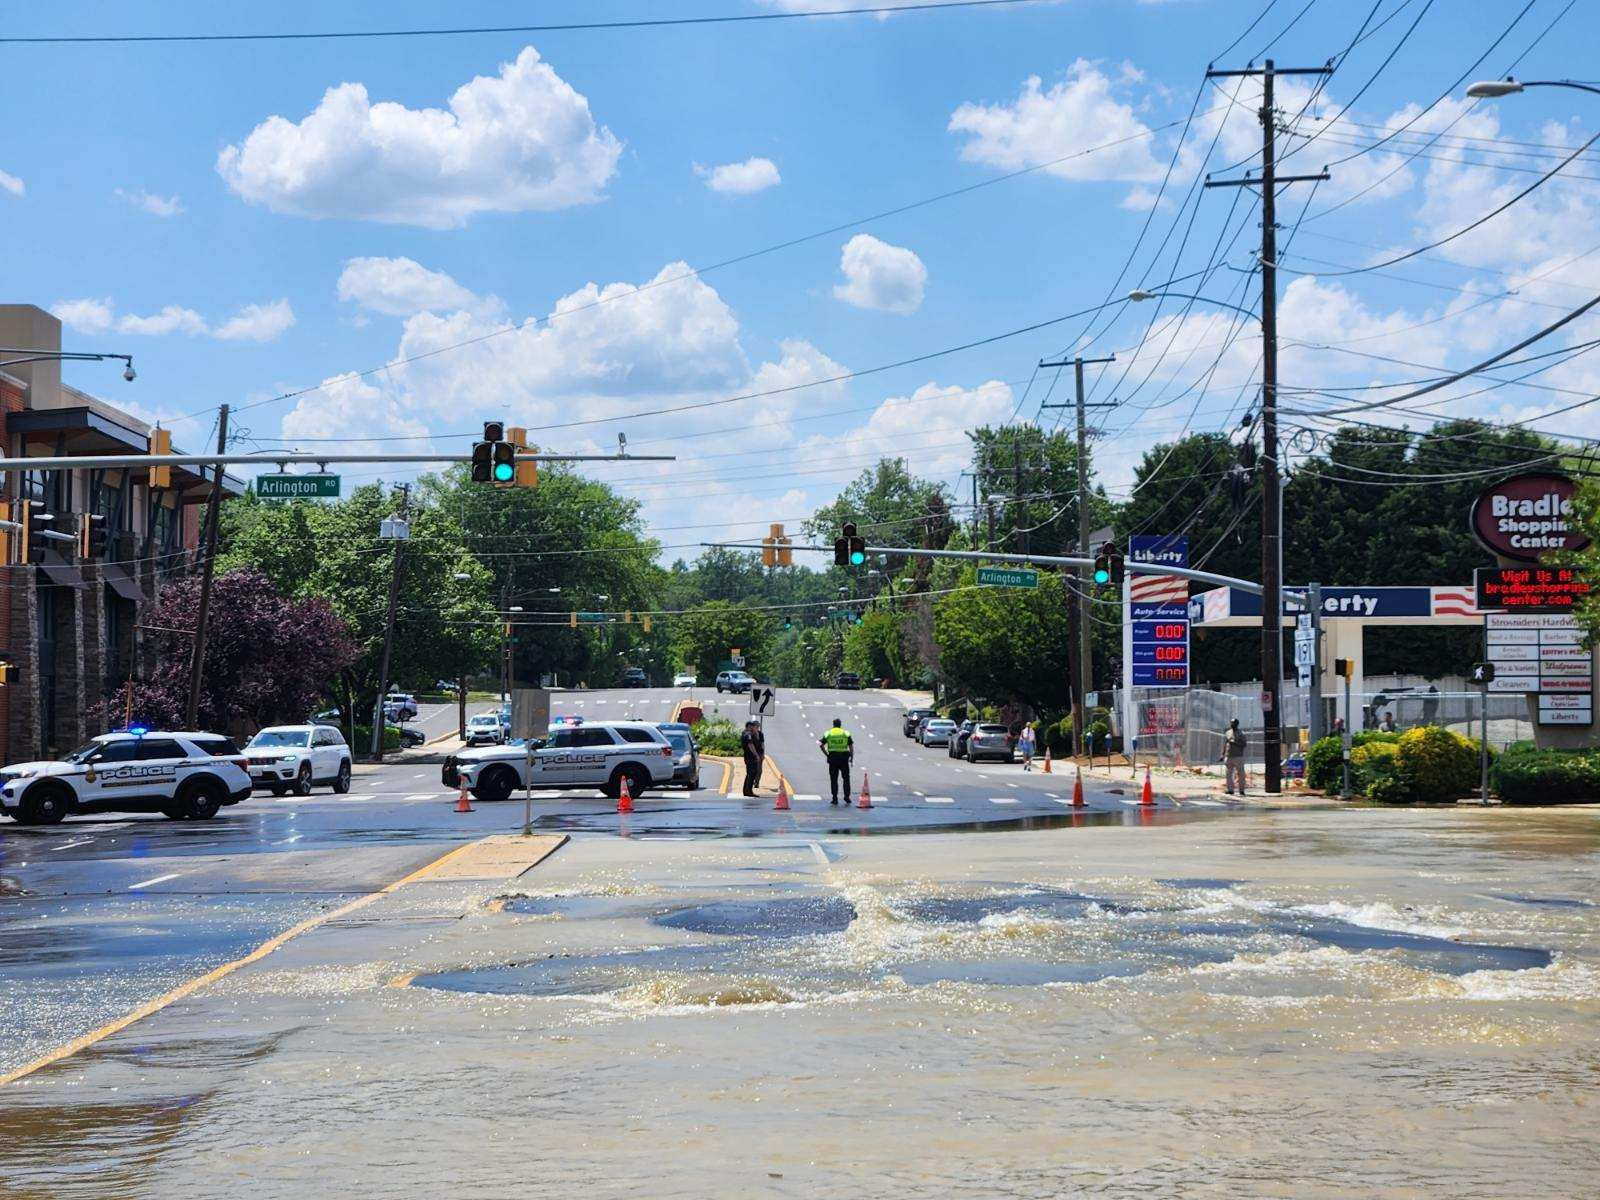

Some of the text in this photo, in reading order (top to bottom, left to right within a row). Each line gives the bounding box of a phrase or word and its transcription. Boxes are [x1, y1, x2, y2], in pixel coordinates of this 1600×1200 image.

[261, 480, 317, 496] Arlington
[1492, 493, 1575, 516] Bradle
[1498, 517, 1571, 534] Shoppin
[1511, 535, 1566, 548] Center
[1134, 549, 1183, 563] Liberty
[981, 571, 1021, 585] Arlington
[1286, 594, 1378, 615] Lerty
[541, 754, 606, 764] POLICE
[101, 766, 176, 780] POLICE
